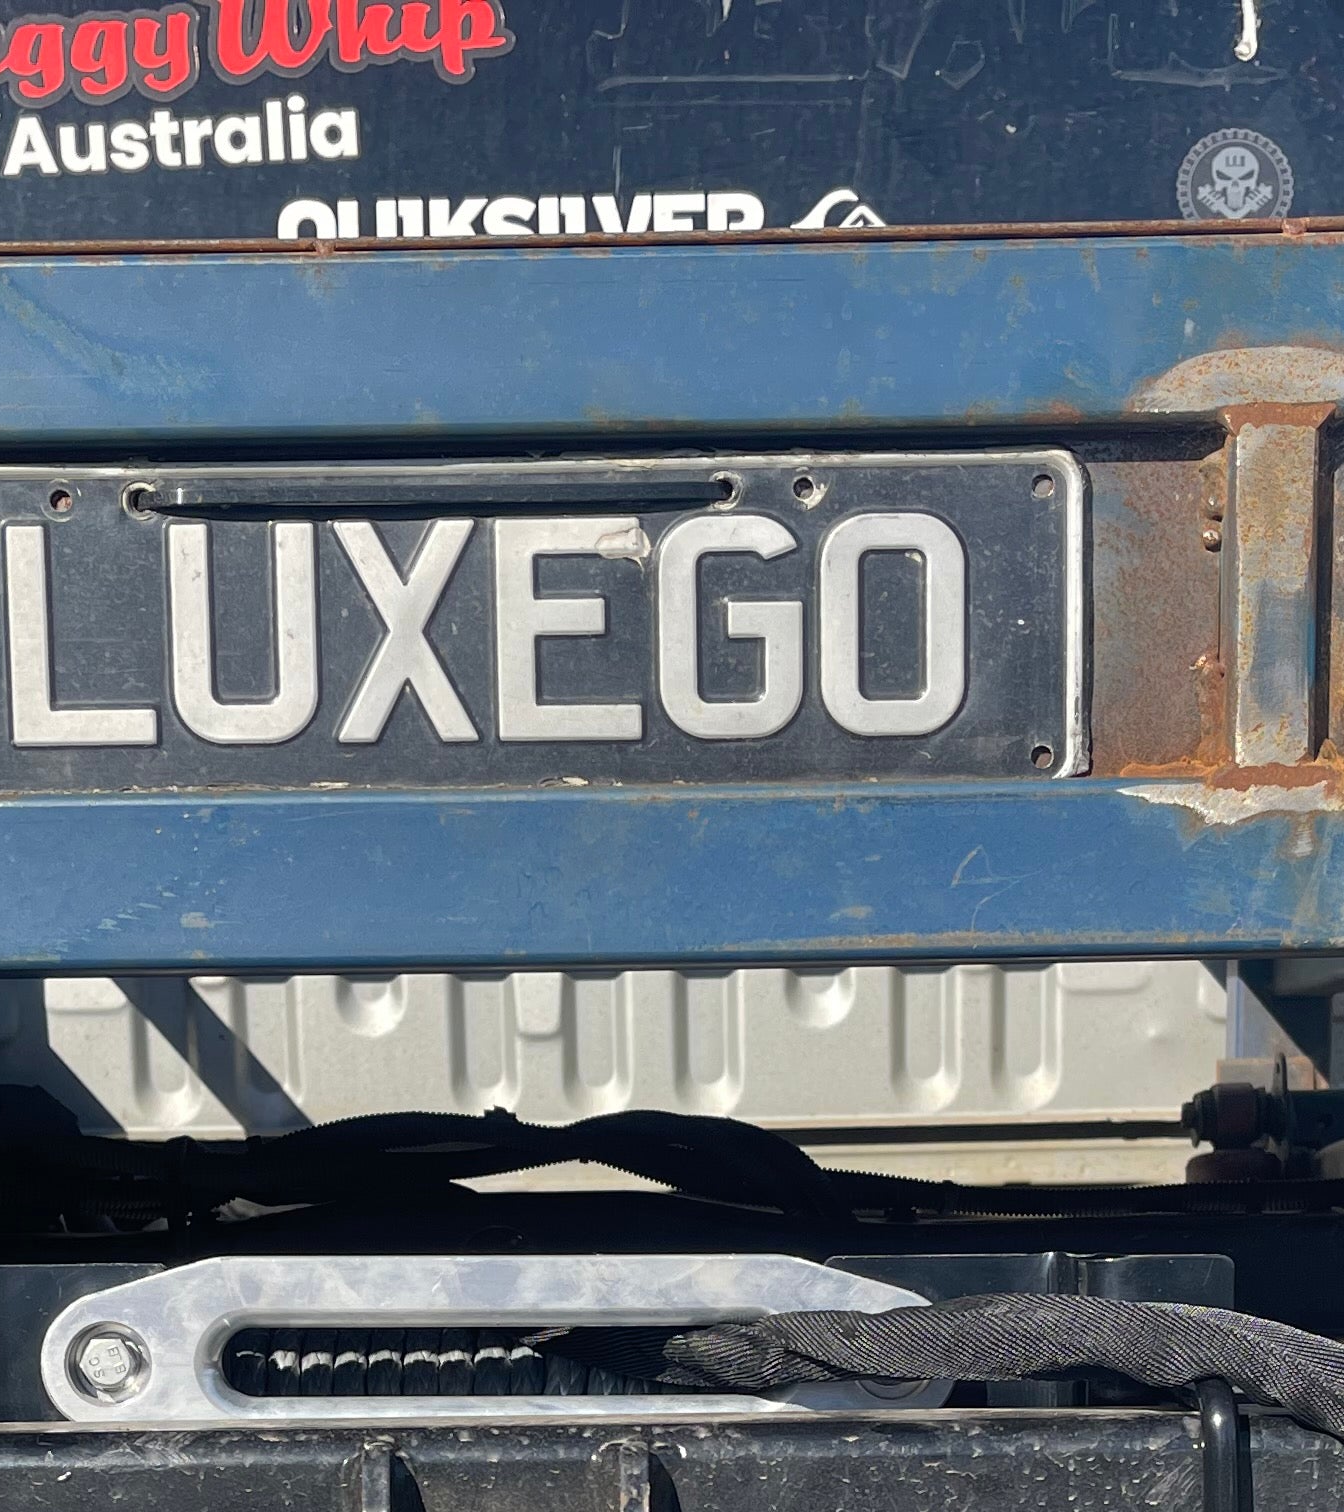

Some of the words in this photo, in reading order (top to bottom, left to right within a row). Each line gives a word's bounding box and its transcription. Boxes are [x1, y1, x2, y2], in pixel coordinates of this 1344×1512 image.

[217, 0, 505, 75] Whip
[2, 94, 358, 176] Australia
[277, 190, 765, 240] QUIKSILVER
[4, 511, 968, 748] LUXEGO
